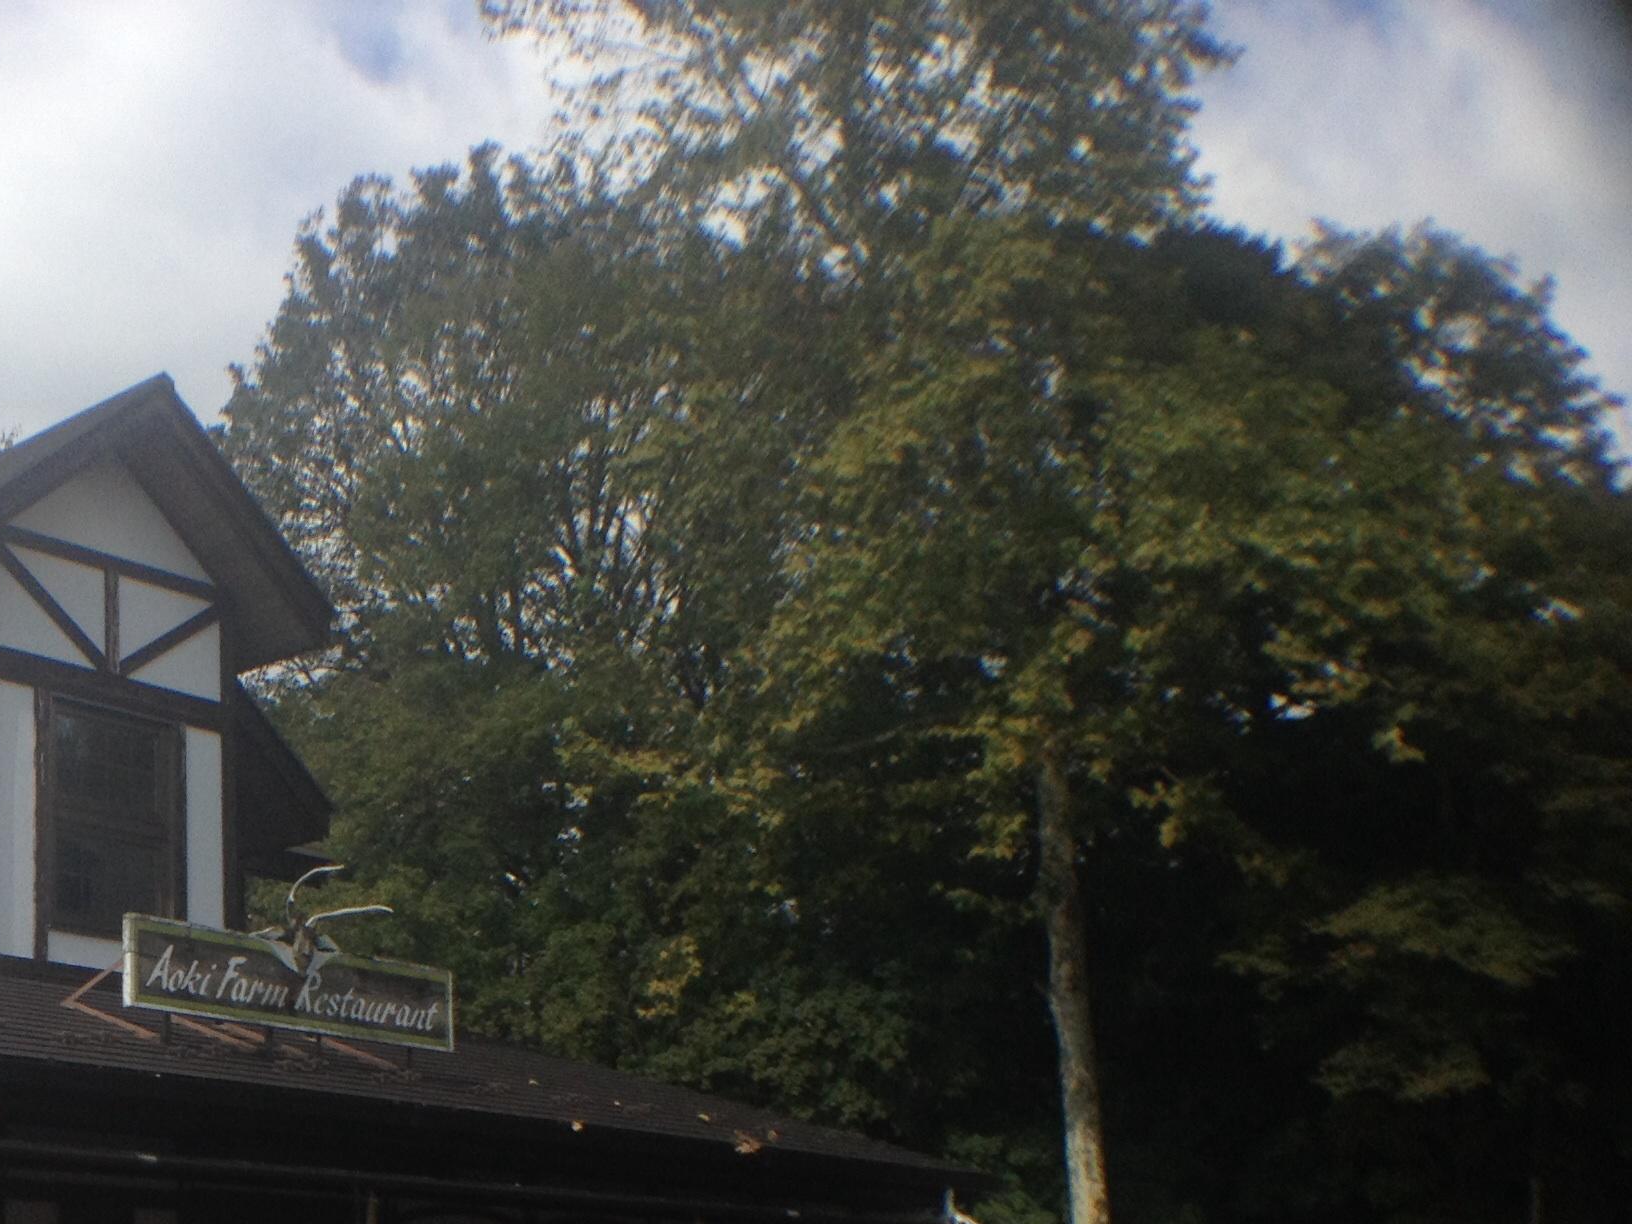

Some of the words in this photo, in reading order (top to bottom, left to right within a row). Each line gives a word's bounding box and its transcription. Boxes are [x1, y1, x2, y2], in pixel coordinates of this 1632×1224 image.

[145, 944, 216, 996] Aoki
[215, 956, 289, 1008] Farm
[294, 970, 439, 1032] Restaurant
